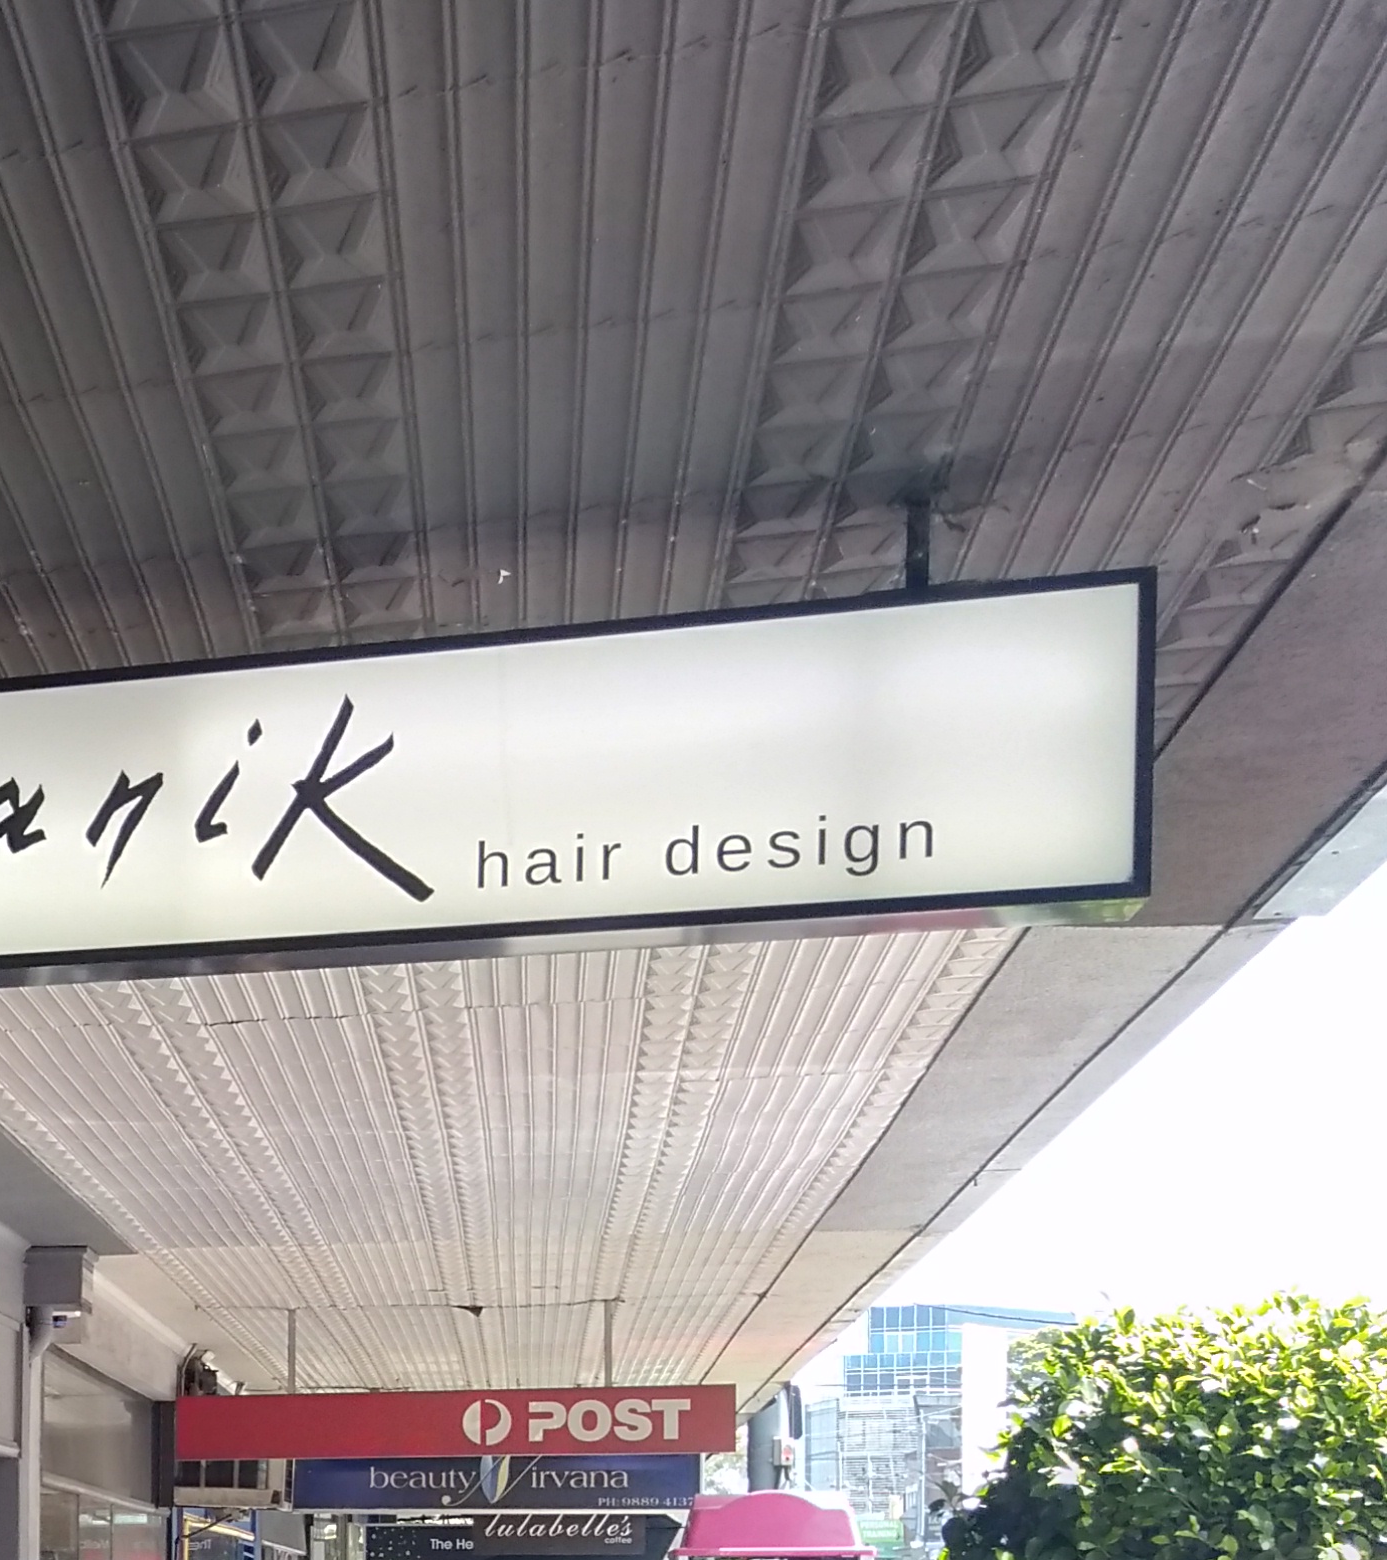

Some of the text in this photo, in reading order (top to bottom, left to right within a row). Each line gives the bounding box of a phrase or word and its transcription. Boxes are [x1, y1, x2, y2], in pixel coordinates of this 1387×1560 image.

[474, 812, 940, 890] hair design
[528, 1397, 692, 1442] POST
[370, 1466, 477, 1494] beauty
[430, 1538, 452, 1551] The
